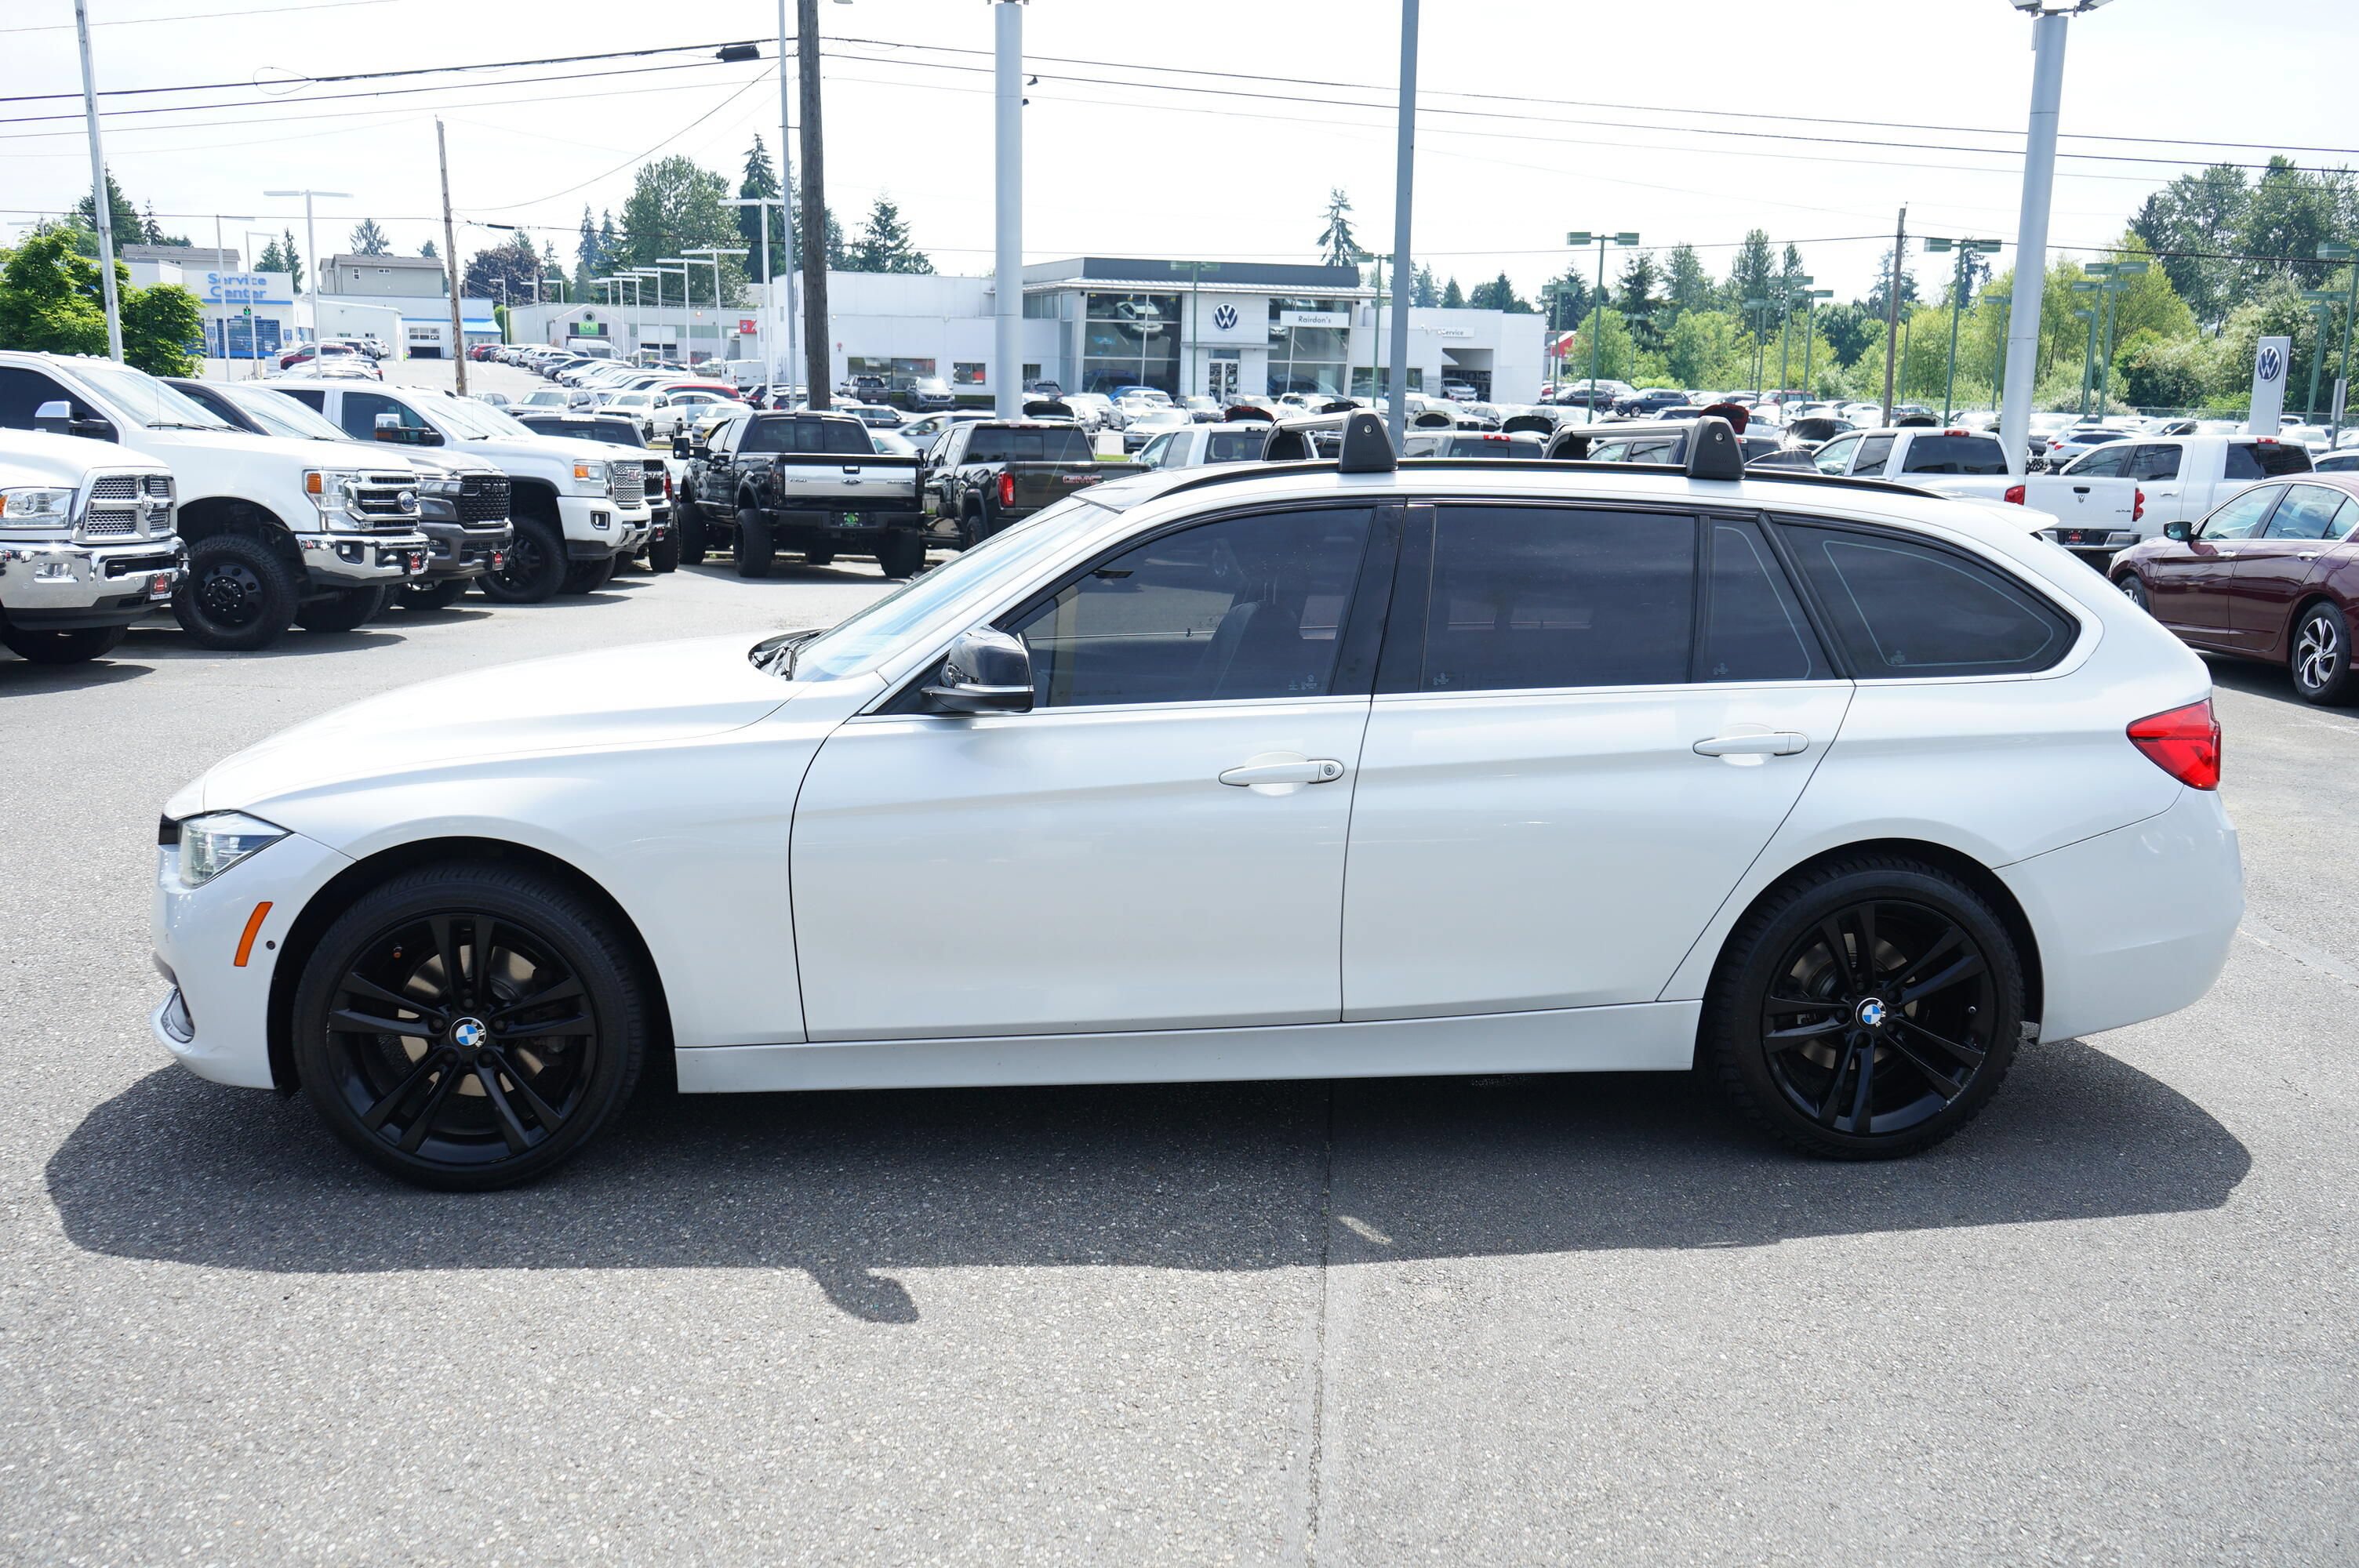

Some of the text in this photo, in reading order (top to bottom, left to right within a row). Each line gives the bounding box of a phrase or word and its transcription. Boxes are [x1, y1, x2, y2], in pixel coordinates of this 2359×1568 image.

[208, 273, 267, 285] Service
[210, 285, 267, 298] Center
[1298, 315, 1331, 324] Rairdon's
[1063, 475, 1102, 485] GMC
